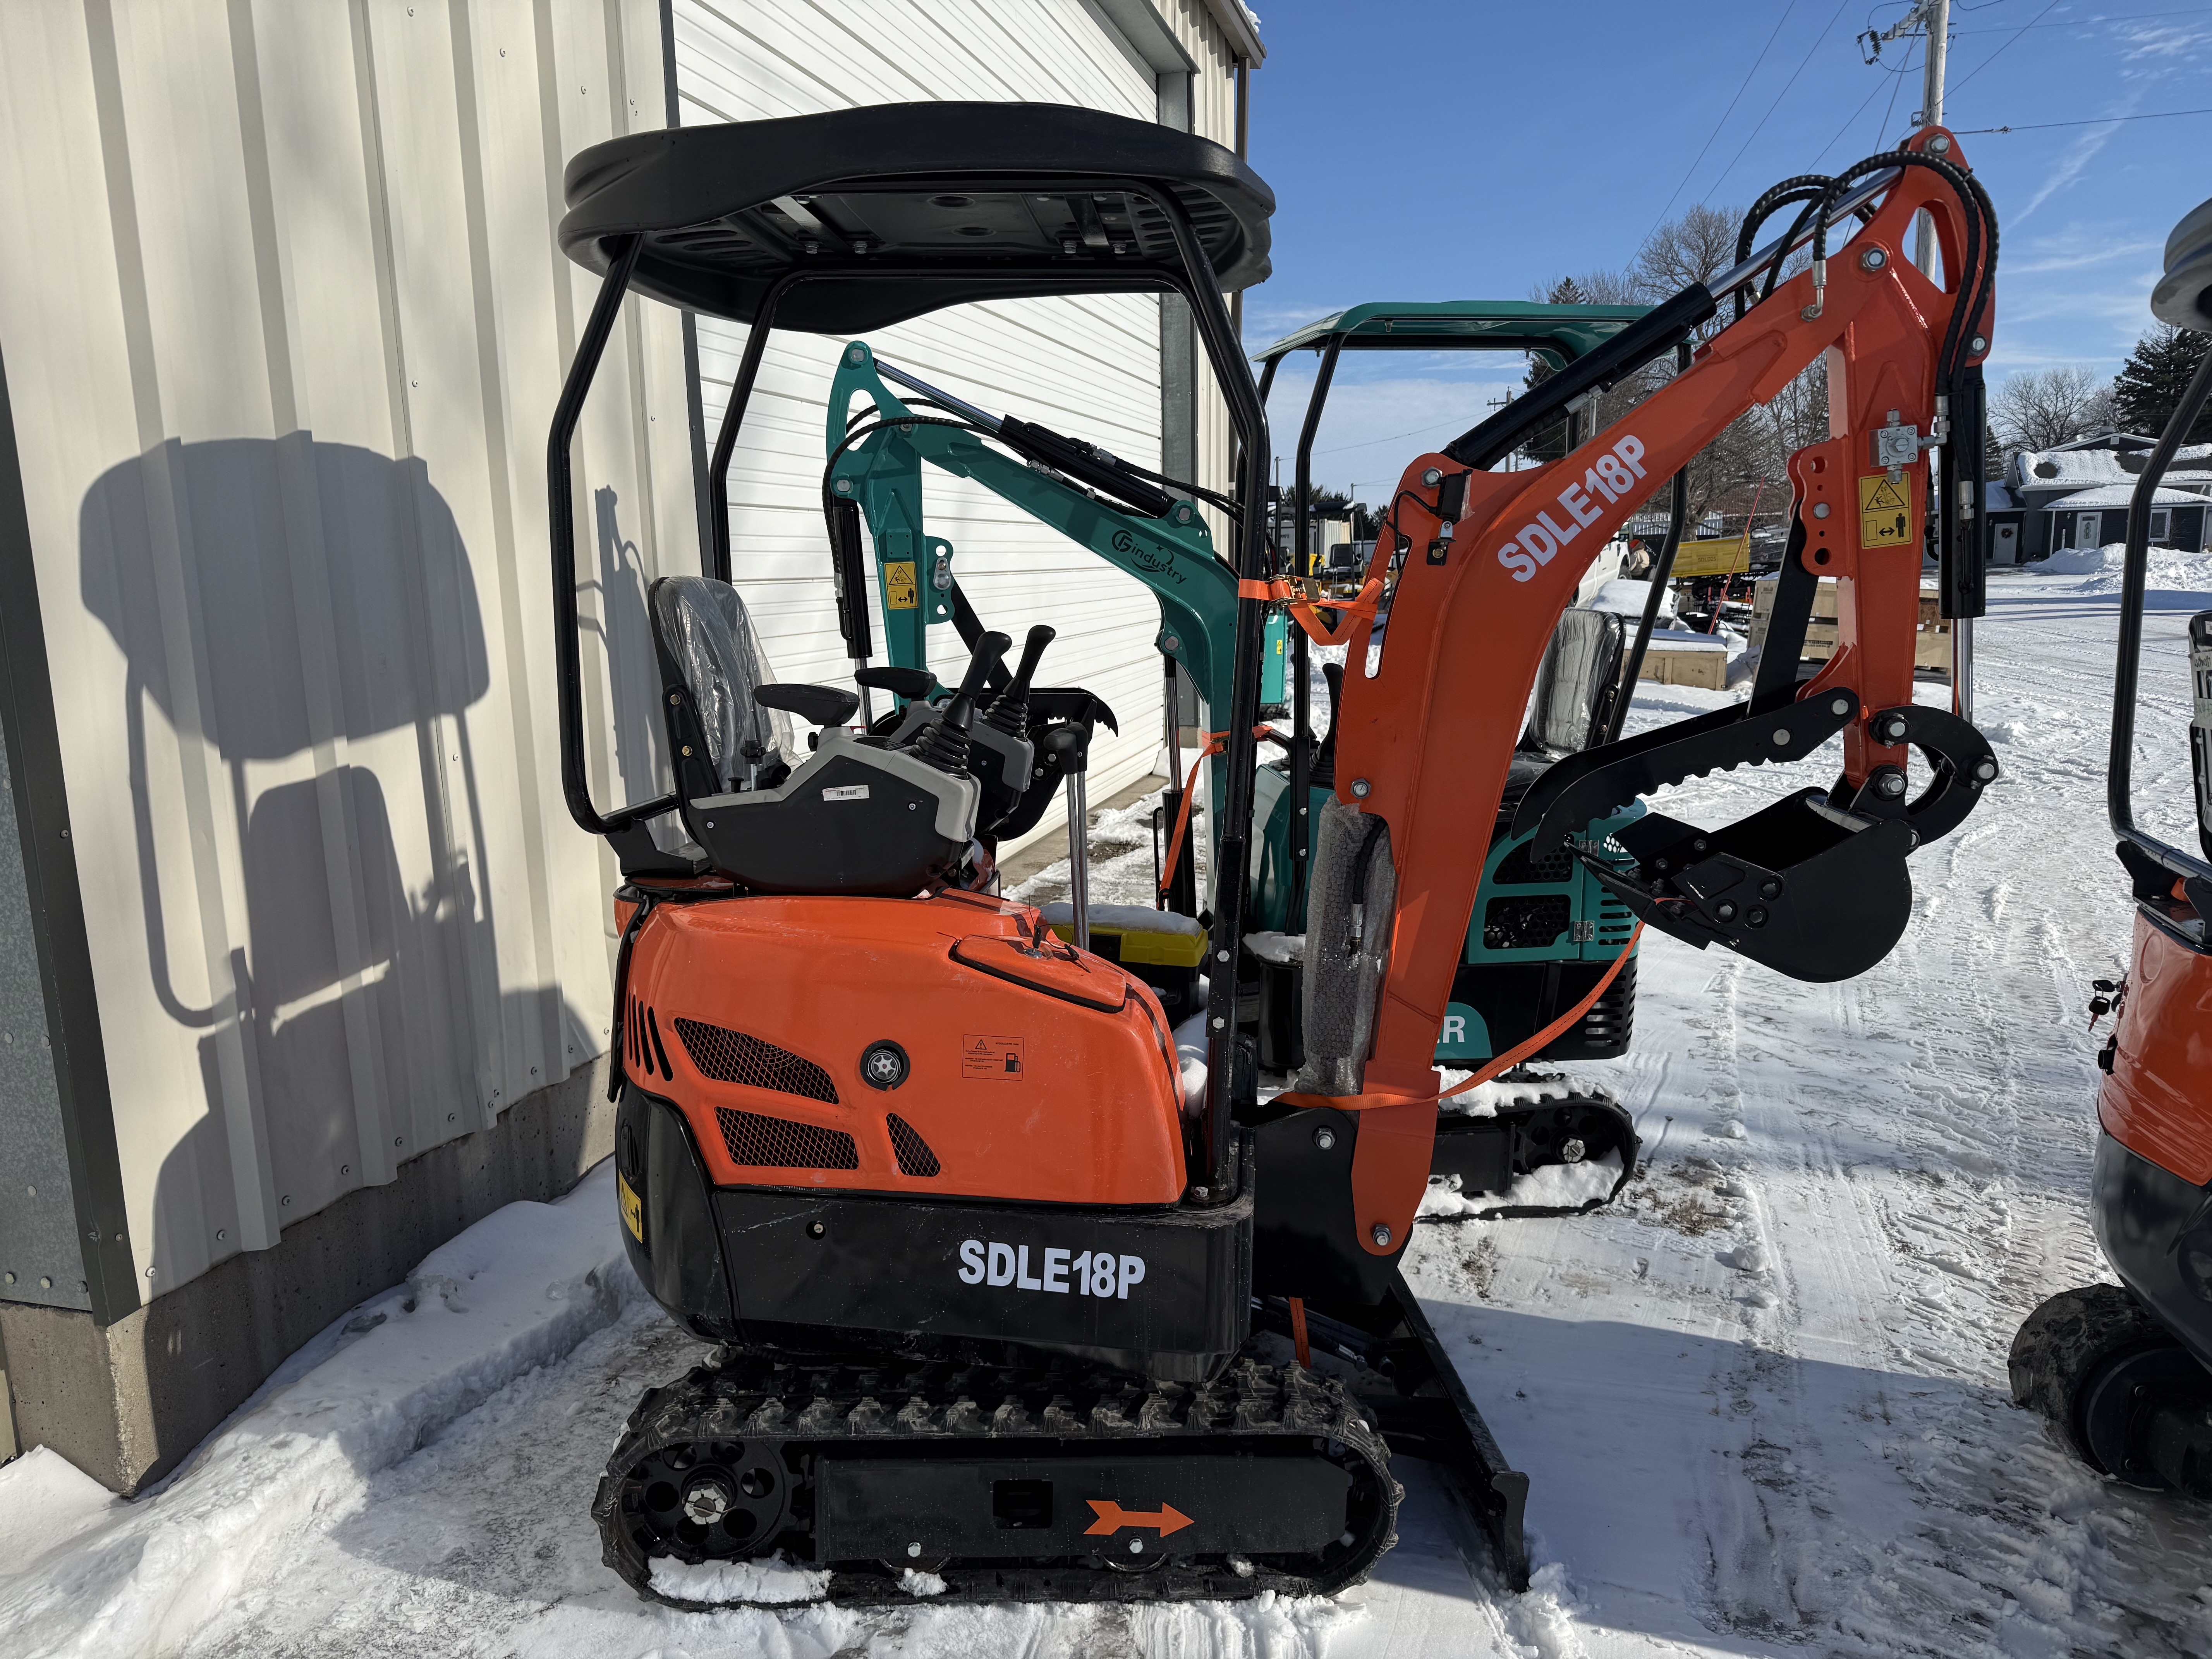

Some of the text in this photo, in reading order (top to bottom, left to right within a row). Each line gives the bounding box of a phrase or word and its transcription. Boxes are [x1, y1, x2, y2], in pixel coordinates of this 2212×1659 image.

[1498, 435, 1647, 582] SDLE18P
[1131, 543, 1187, 584] industry
[1437, 1016, 1465, 1043] R
[958, 1240, 1145, 1299] SDLE18P
